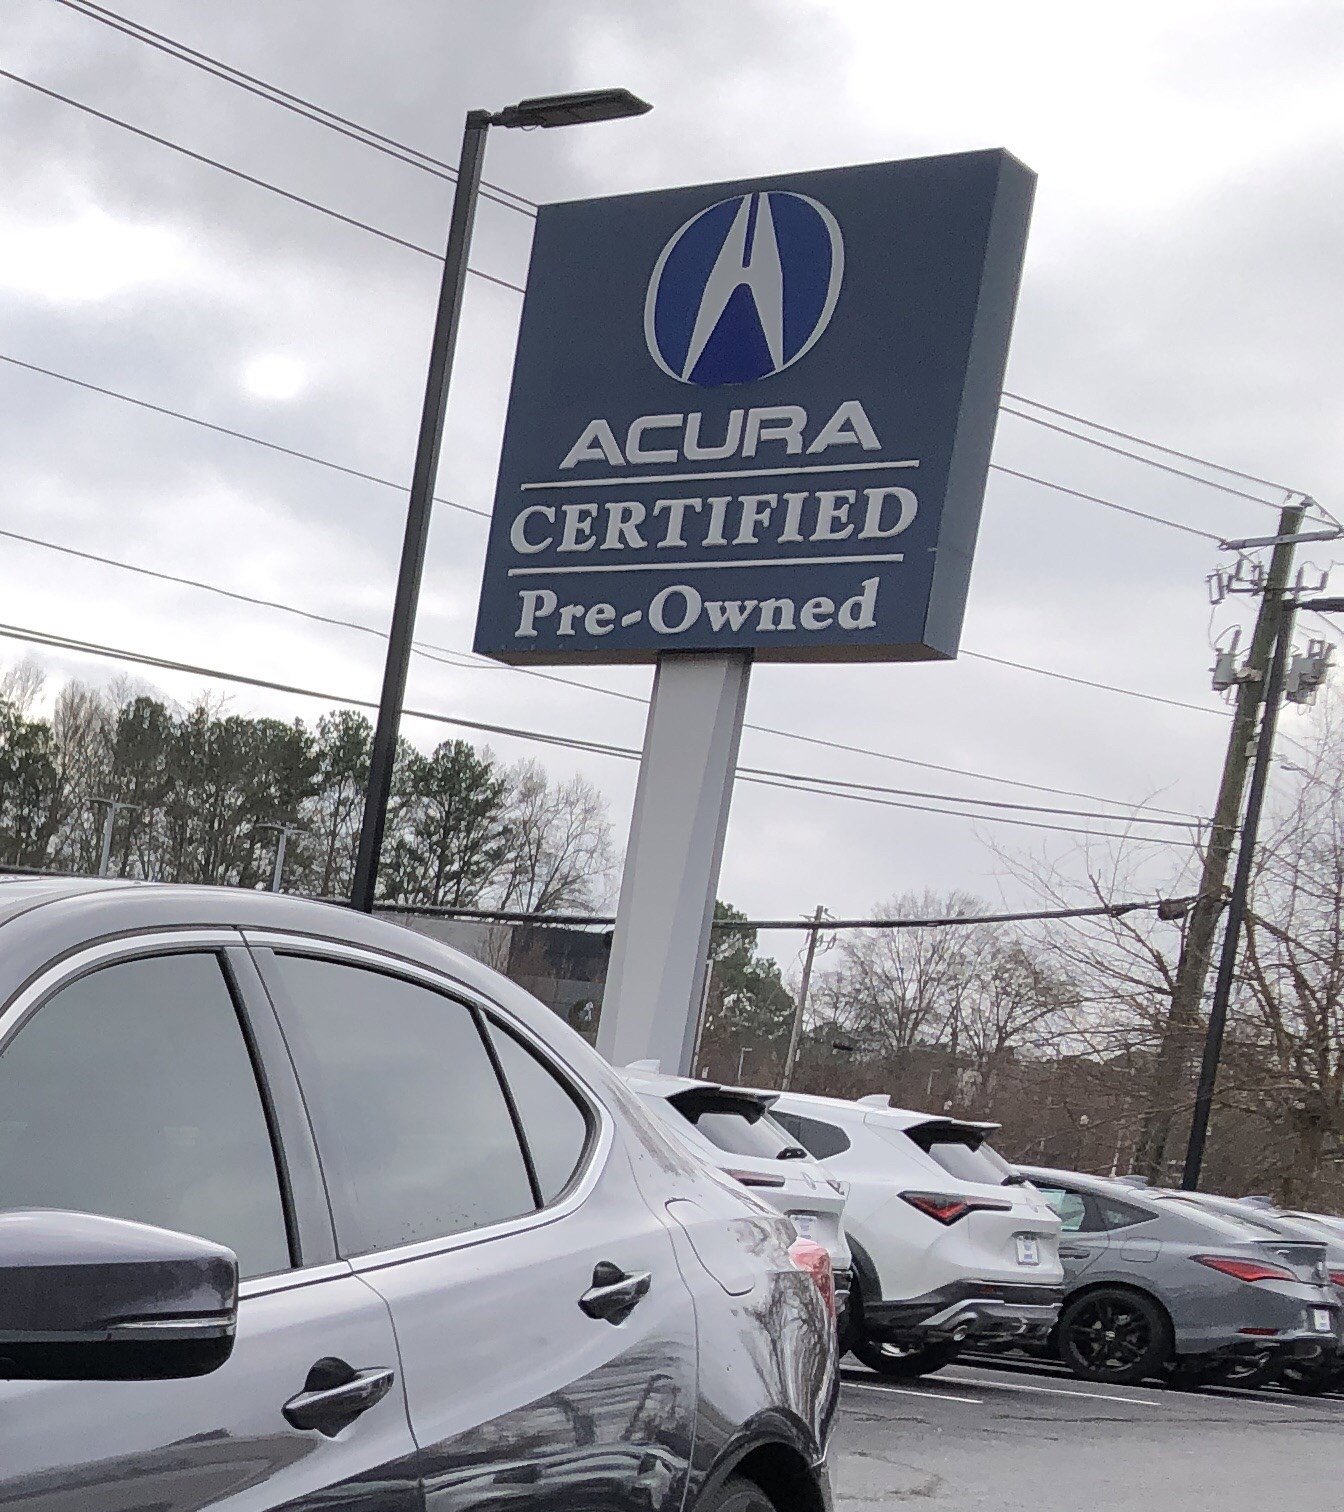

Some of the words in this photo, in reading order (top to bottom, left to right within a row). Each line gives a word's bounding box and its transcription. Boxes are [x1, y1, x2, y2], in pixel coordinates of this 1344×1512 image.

[558, 399, 883, 470] ACURA
[509, 485, 920, 555] CERTIFIED
[513, 576, 881, 639] Pre-Owned
